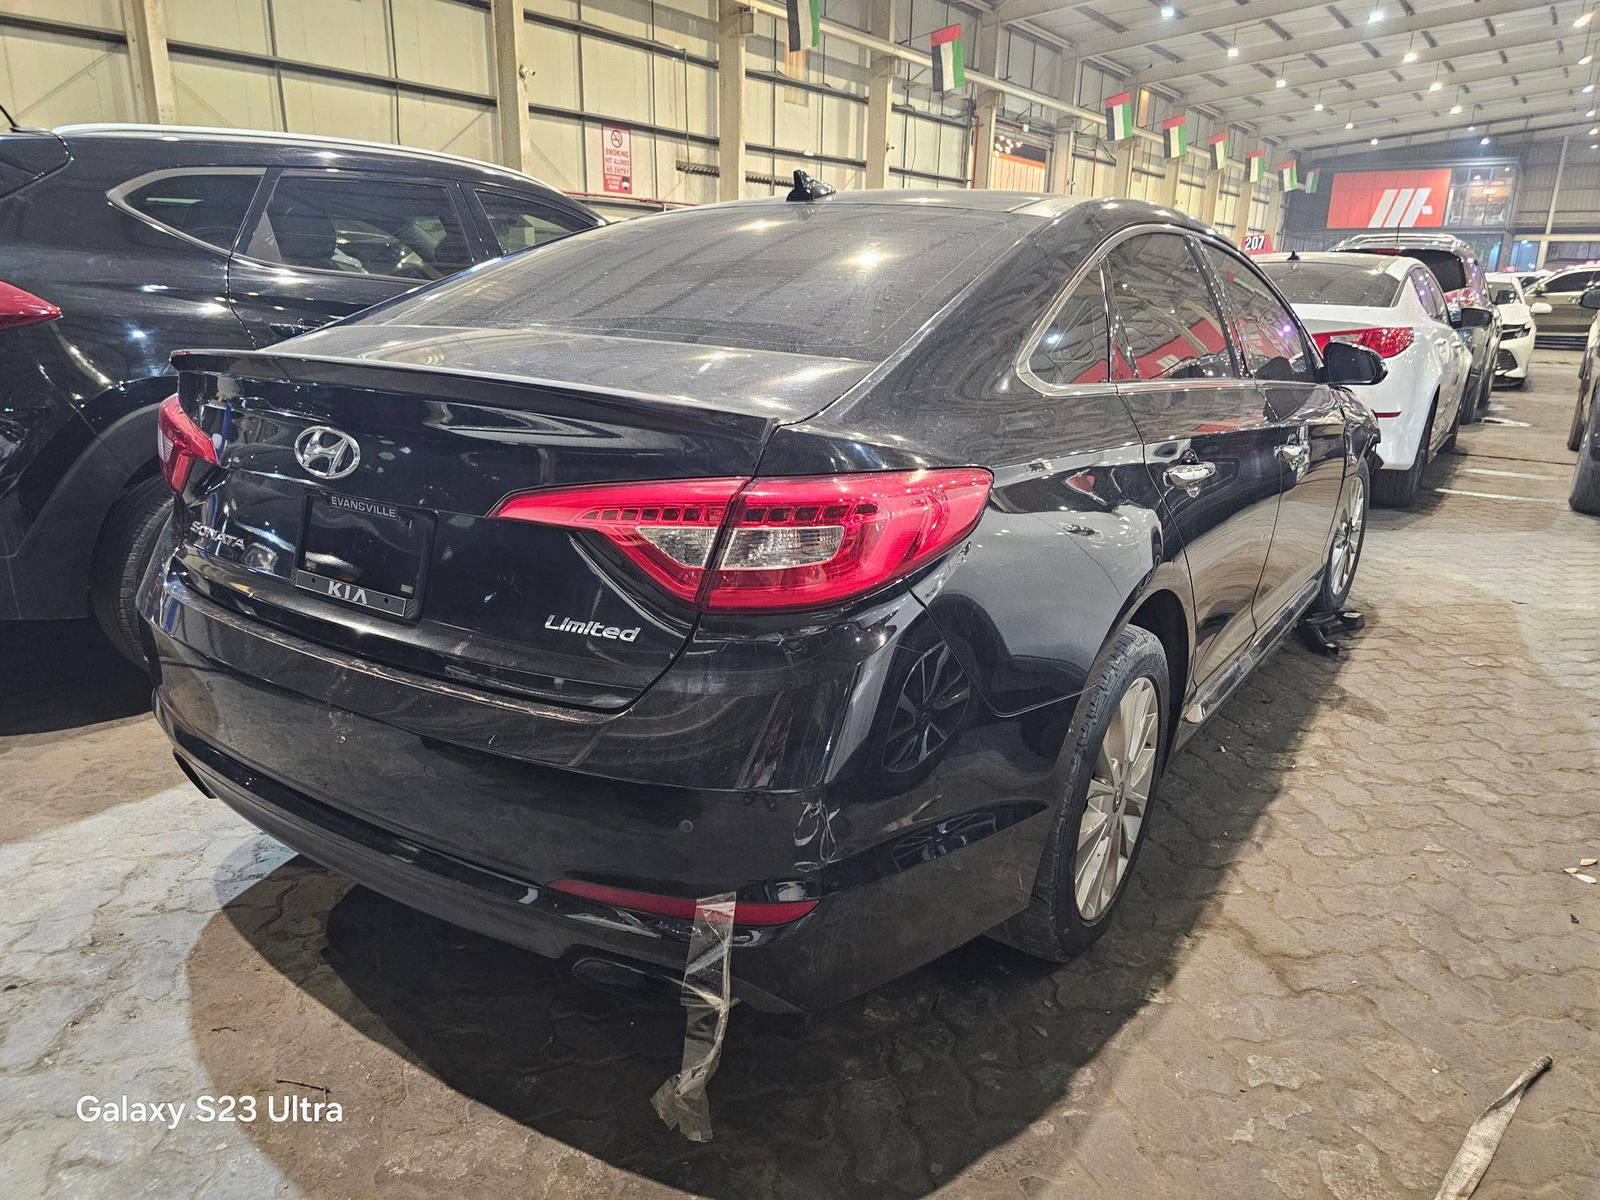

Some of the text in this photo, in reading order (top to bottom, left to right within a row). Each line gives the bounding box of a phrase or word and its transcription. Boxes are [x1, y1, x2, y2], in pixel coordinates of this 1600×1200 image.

[1245, 235, 1265, 250] 207
[331, 496, 397, 518] EVANSVILLE
[190, 521, 245, 550] SONATA
[327, 580, 368, 605] KIA
[544, 614, 641, 642] Limited
